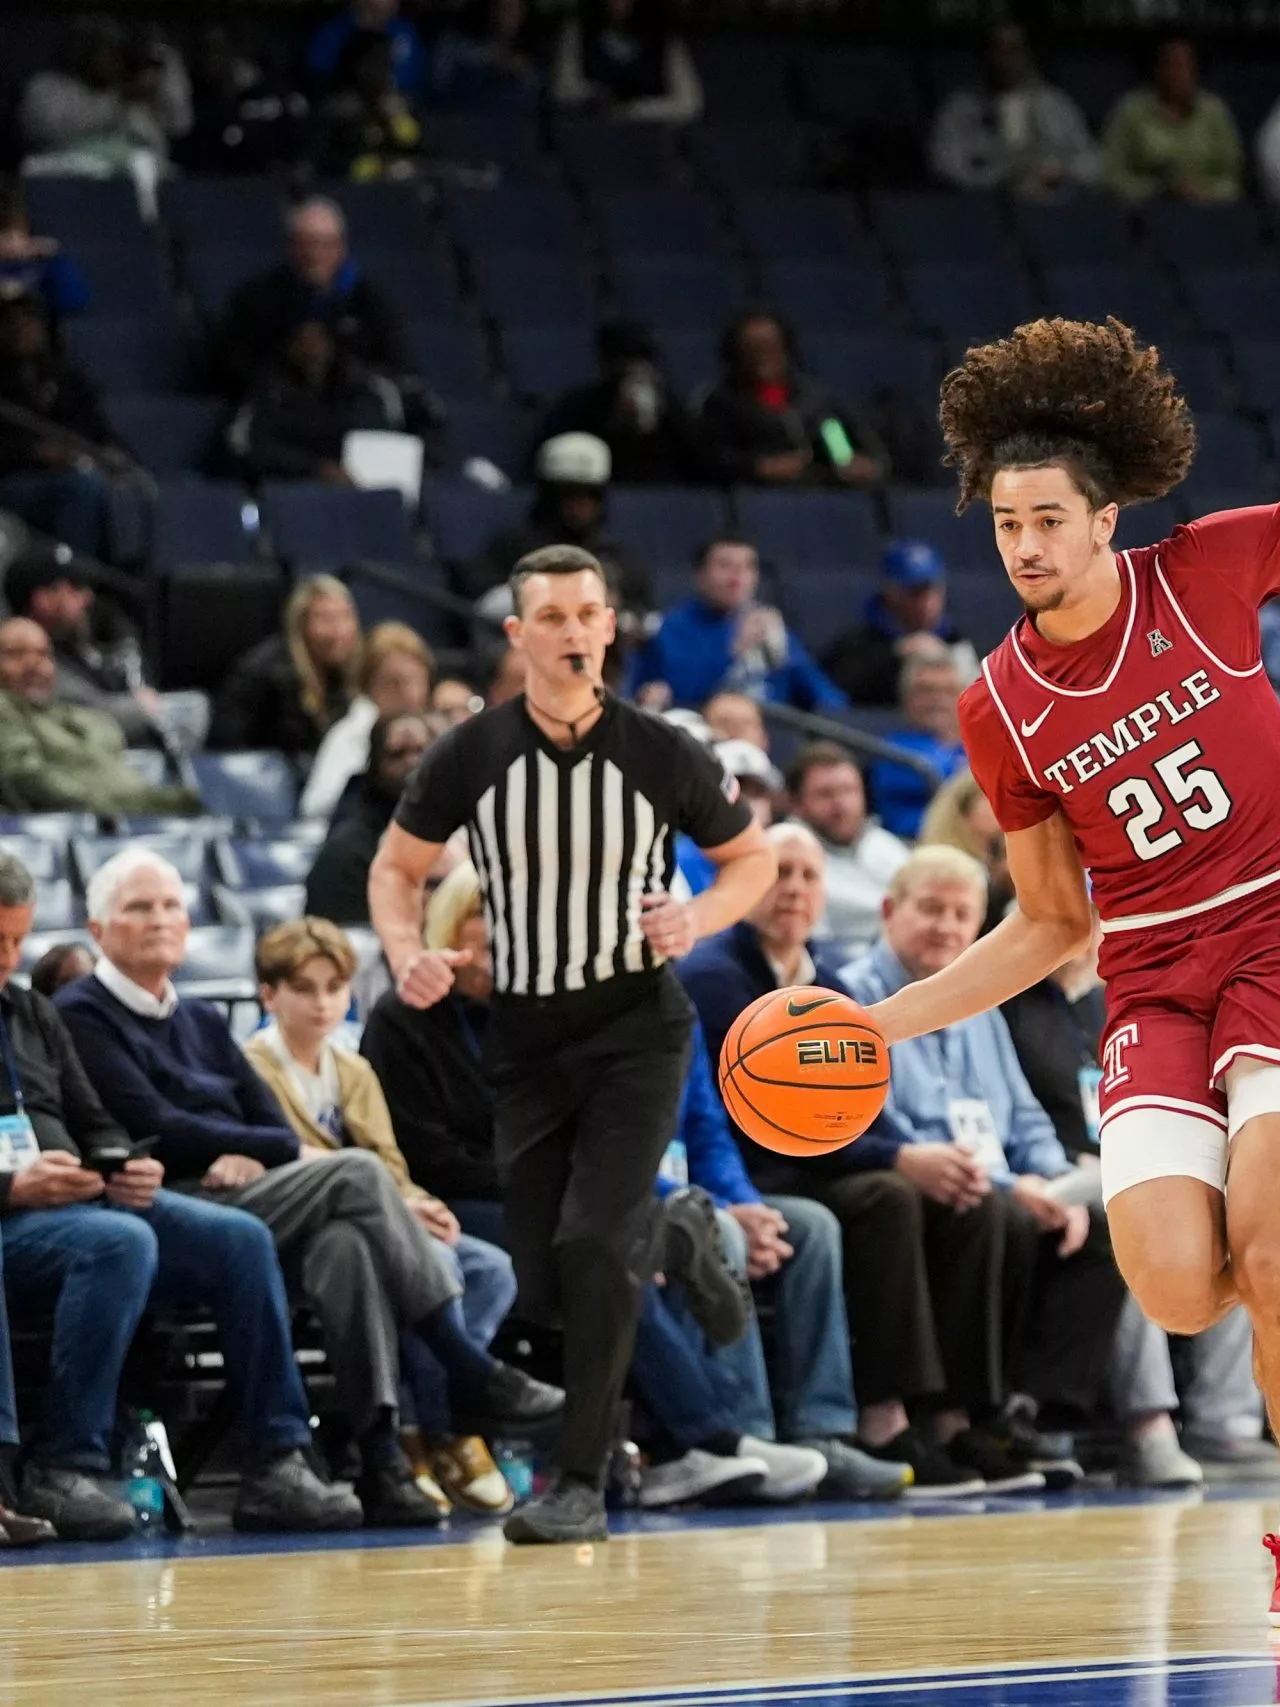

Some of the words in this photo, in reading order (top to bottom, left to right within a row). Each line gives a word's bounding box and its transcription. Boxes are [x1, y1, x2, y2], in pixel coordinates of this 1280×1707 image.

[1043, 669, 1221, 794] TEMPLE
[1107, 738, 1233, 861] 25
[1103, 1022, 1139, 1094] T
